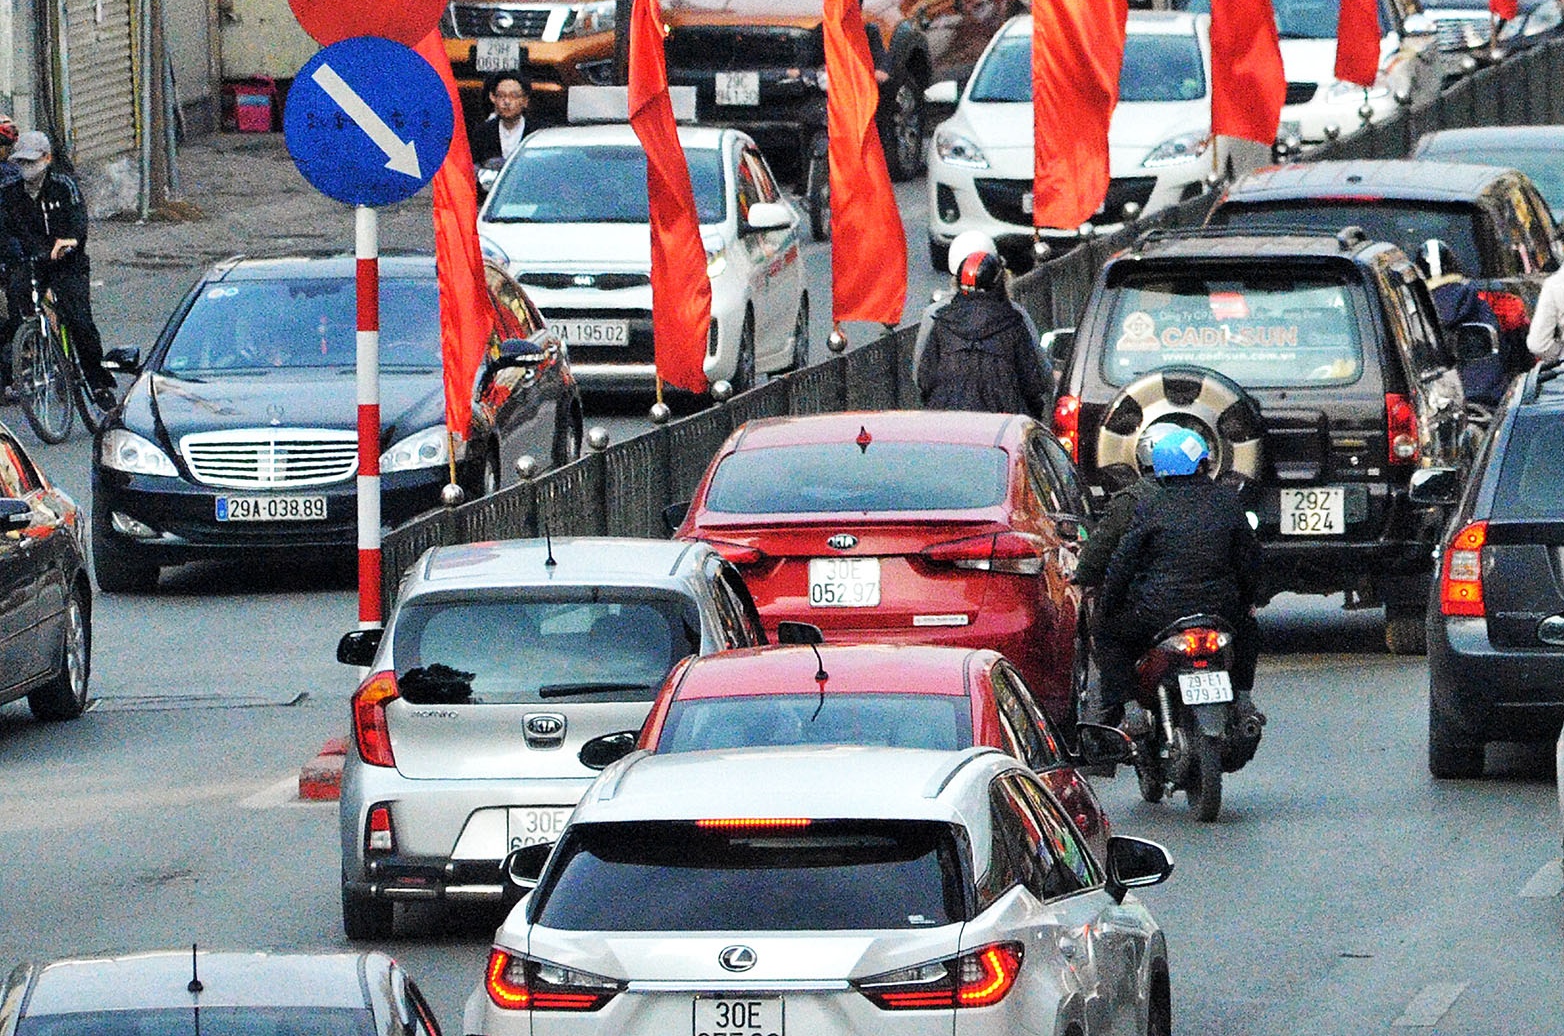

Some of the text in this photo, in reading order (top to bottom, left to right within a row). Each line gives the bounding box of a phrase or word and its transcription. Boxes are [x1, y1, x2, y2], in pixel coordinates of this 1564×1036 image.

[229, 498, 325, 519] 29A-038.89
[1294, 492, 1331, 511] 29Z
[1291, 513, 1334, 531] 1824
[715, 1001, 762, 1029] 30E
